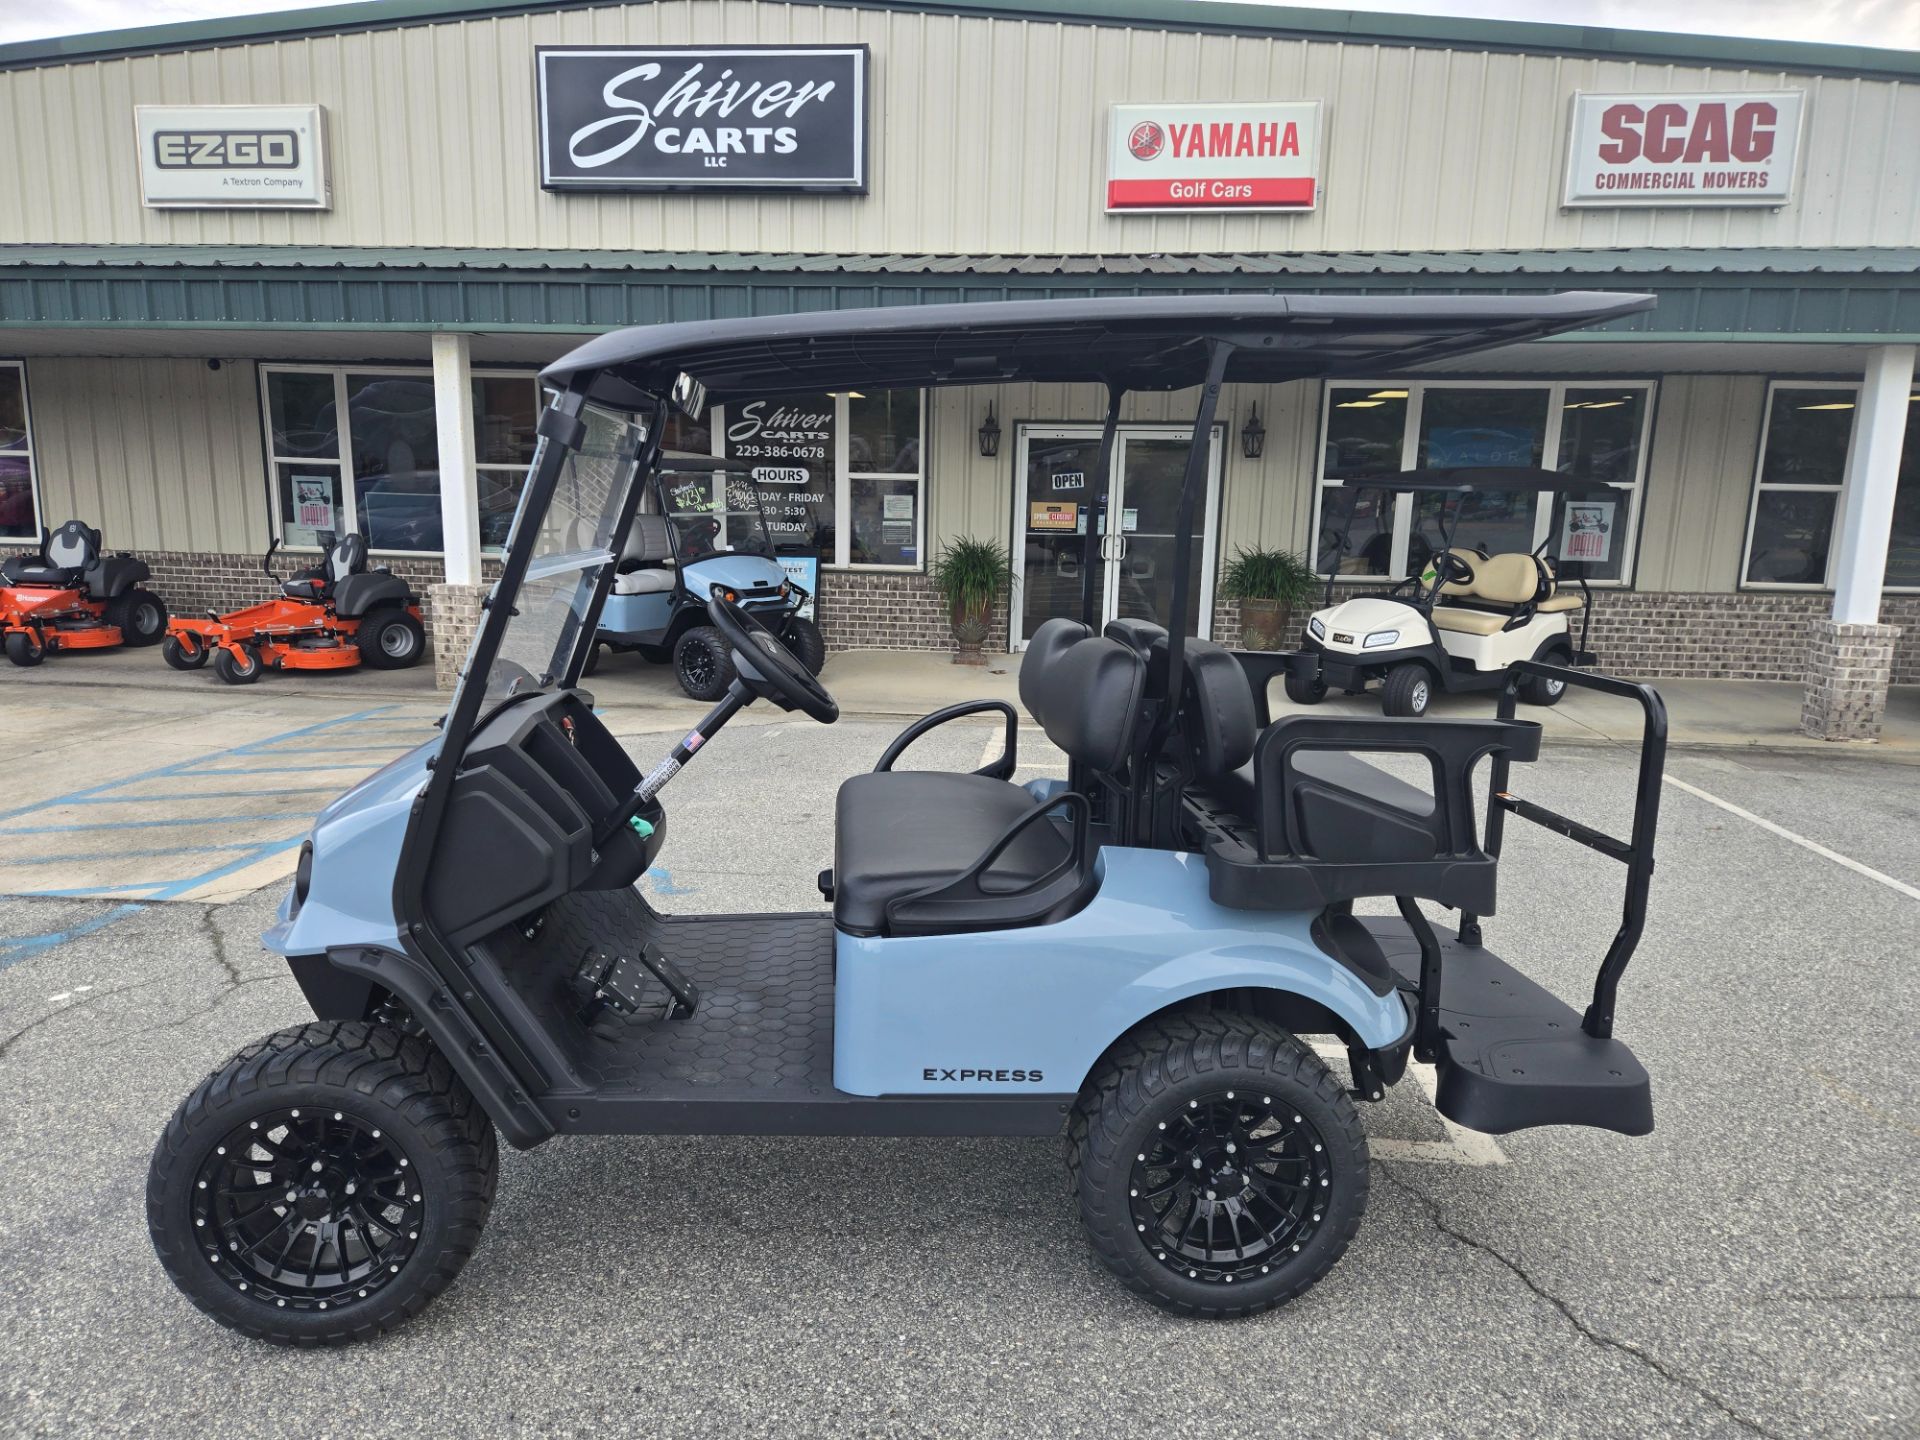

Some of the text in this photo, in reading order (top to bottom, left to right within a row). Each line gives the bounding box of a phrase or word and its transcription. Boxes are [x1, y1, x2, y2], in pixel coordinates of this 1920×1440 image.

[569, 62, 836, 169] Shiver
[654, 127, 798, 154] CARTS
[1168, 122, 1300, 158] YAMAHA
[1598, 102, 1778, 164] SCAG
[704, 157, 727, 168] LLC
[222, 178, 303, 188] A Textron Company
[1595, 171, 1769, 190] COMMERCIAL MOWERS
[1170, 181, 1253, 198] Golf Cars
[728, 400, 832, 441] Shiver
[760, 431, 830, 440] CARTS
[735, 445, 825, 458] 229-386-0678
[757, 469, 803, 480] HOURS
[1054, 474, 1082, 488] OPEN
[757, 492, 781, 501] DAY
[788, 493, 824, 503] FRIDAY
[761, 506, 777, 515] :30
[784, 506, 806, 516] 5:30
[1567, 534, 1603, 557] APOLLO
[923, 1068, 1044, 1083] EXPRESS
